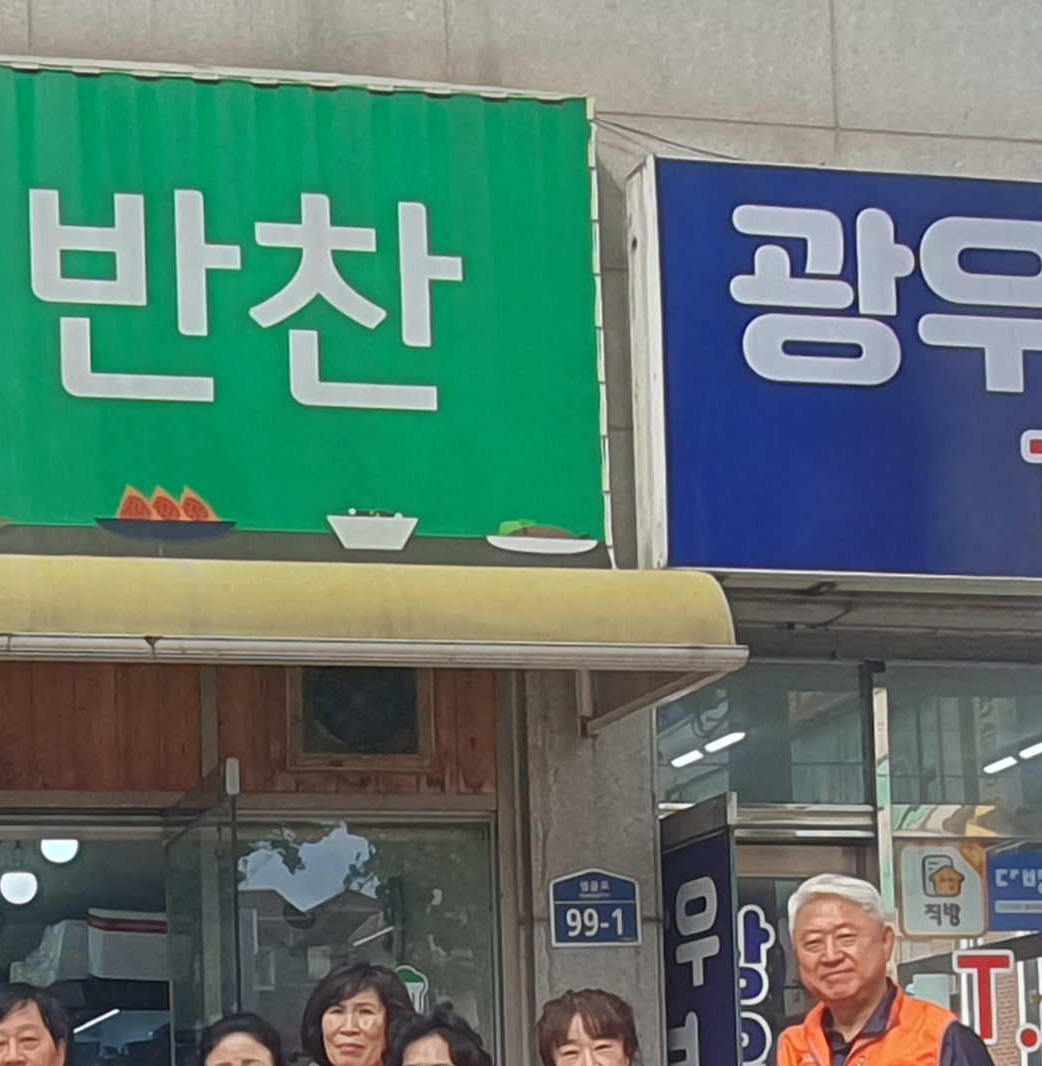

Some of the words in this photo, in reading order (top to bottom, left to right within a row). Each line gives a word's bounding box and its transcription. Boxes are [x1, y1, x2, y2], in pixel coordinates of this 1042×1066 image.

[28, 188, 465, 412] 반찬
[728, 203, 1042, 393] 광우
[566, 908, 623, 937] 99-1
[924, 902, 962, 927] 직방
